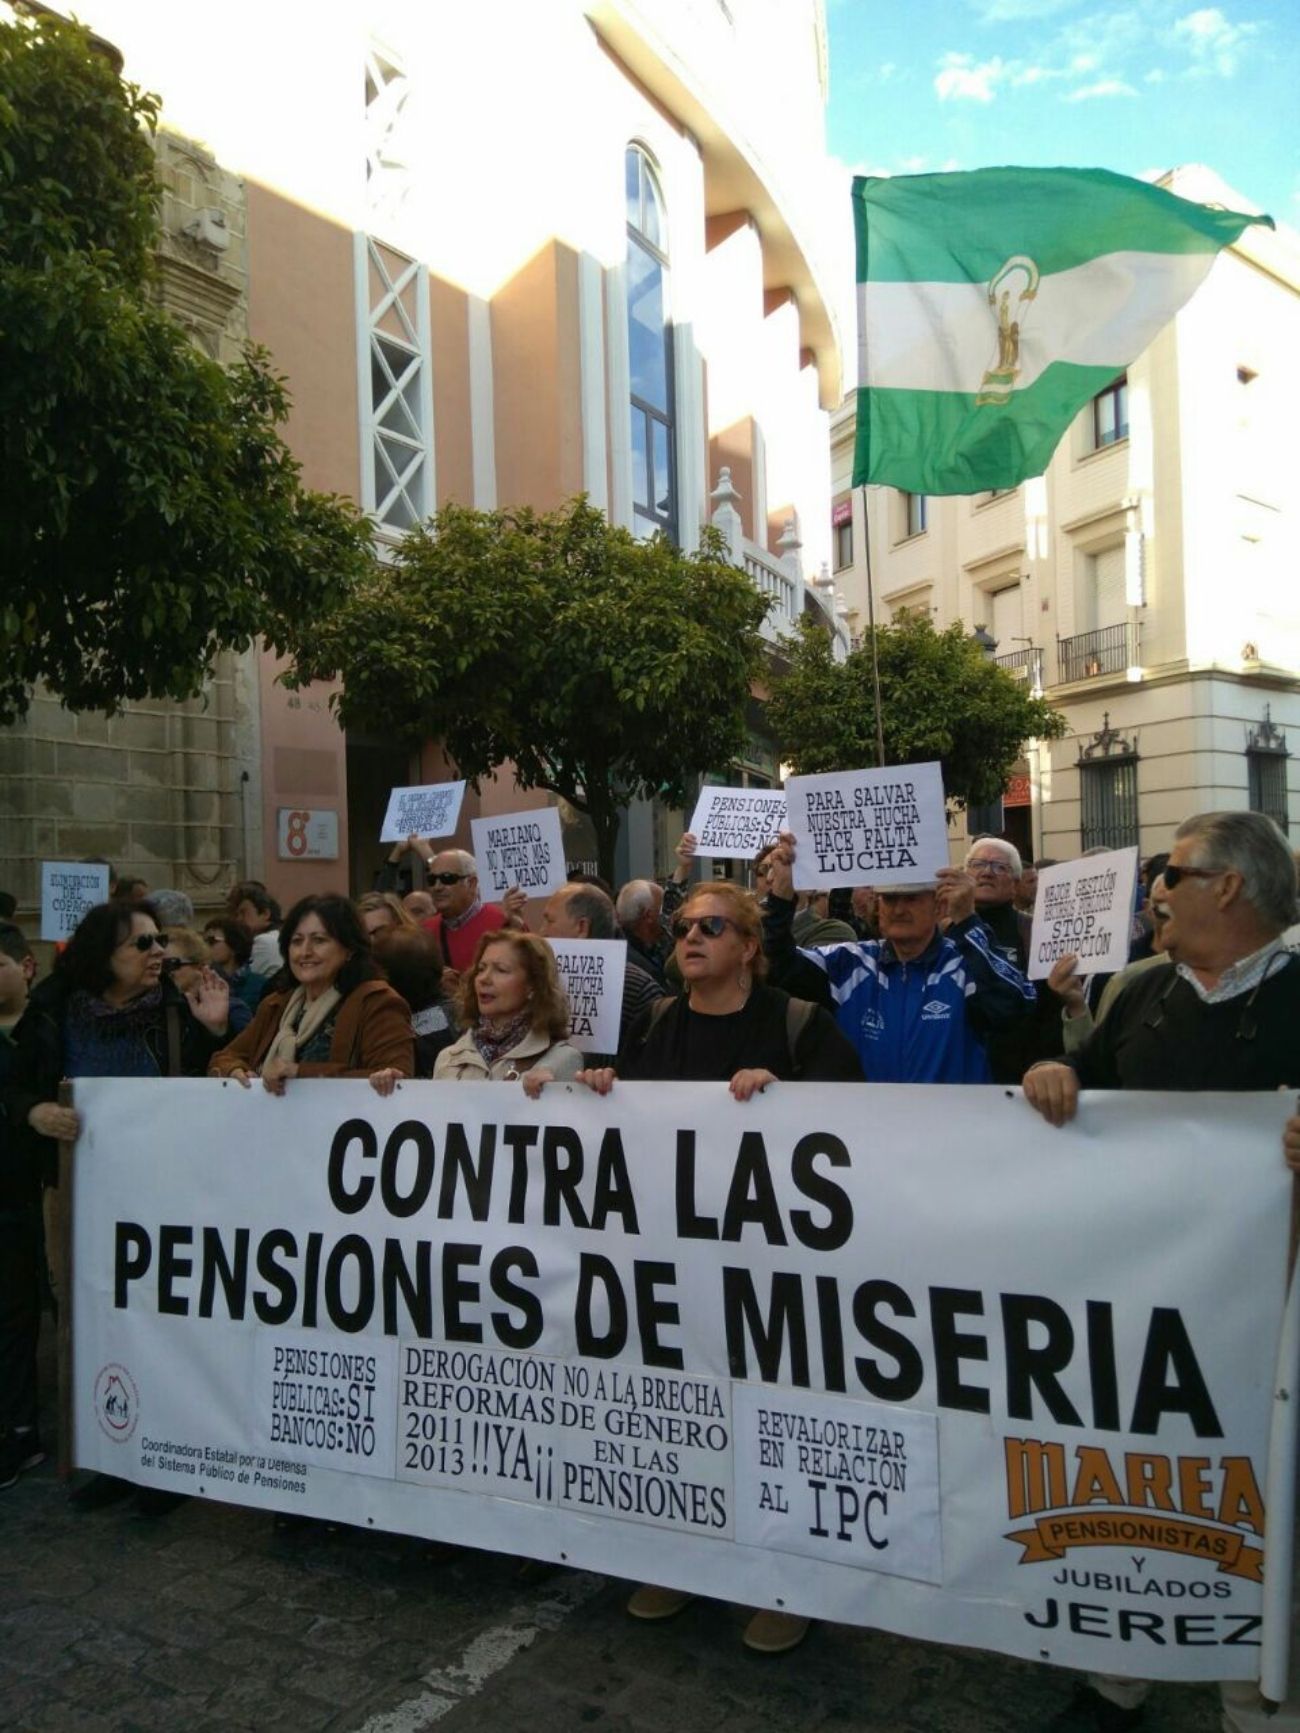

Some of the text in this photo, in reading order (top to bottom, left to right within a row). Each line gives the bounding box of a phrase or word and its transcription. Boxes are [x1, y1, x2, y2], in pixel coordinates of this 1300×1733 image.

[711, 796, 788, 814] PENSIONES
[806, 783, 917, 811] PARA SALVAR
[807, 805, 921, 832] NUESTRA HUCHA
[487, 823, 541, 848] MARIANO
[814, 826, 918, 853] HACE FALTA
[486, 850, 497, 870] NO
[501, 846, 528, 869] METAS
[818, 849, 918, 873] LUCHA
[63, 887, 82, 899] DEL
[492, 871, 509, 890] LA
[515, 865, 548, 887] MANO
[52, 899, 93, 913] COPAGO
[1052, 915, 1095, 939] STOP
[1039, 927, 1112, 963] CORRUPCIÓN
[568, 976, 604, 995] HUCHA
[328, 1119, 853, 1251] CONTRA LAS
[115, 1222, 1224, 1438] PENSIONES DE MISERIA
[273, 1347, 376, 1383] PENSIONES
[405, 1348, 555, 1392] DEROGACIÓN
[403, 1380, 555, 1424] REFORMAS
[563, 1365, 725, 1418] NO A LA BRECHA
[406, 1412, 463, 1443] 2011
[561, 1401, 728, 1451] DE GÉNERO
[758, 1409, 907, 1460] REVALORIZAR
[142, 1437, 202, 1459] Coordinadora
[205, 1447, 237, 1464] Estatal
[239, 1455, 254, 1467] por
[405, 1442, 464, 1476] 2013
[593, 1440, 679, 1474] EN LAS
[759, 1439, 907, 1492] EN RELACIÓN
[141, 1454, 155, 1466] del
[158, 1457, 196, 1474] Sistema
[238, 1472, 250, 1483] de
[254, 1474, 306, 1493] Pensiones
[1004, 1436, 1265, 1538] MAREA
[563, 1462, 726, 1528] PENSIONES
[759, 1479, 889, 1550] AL IPC
[1050, 1522, 1228, 1555] PENSIONISTAS
[1131, 1556, 1146, 1573] Y
[1053, 1568, 1232, 1599] JUBILADOS
[1024, 1598, 1263, 1647] JEREZ
